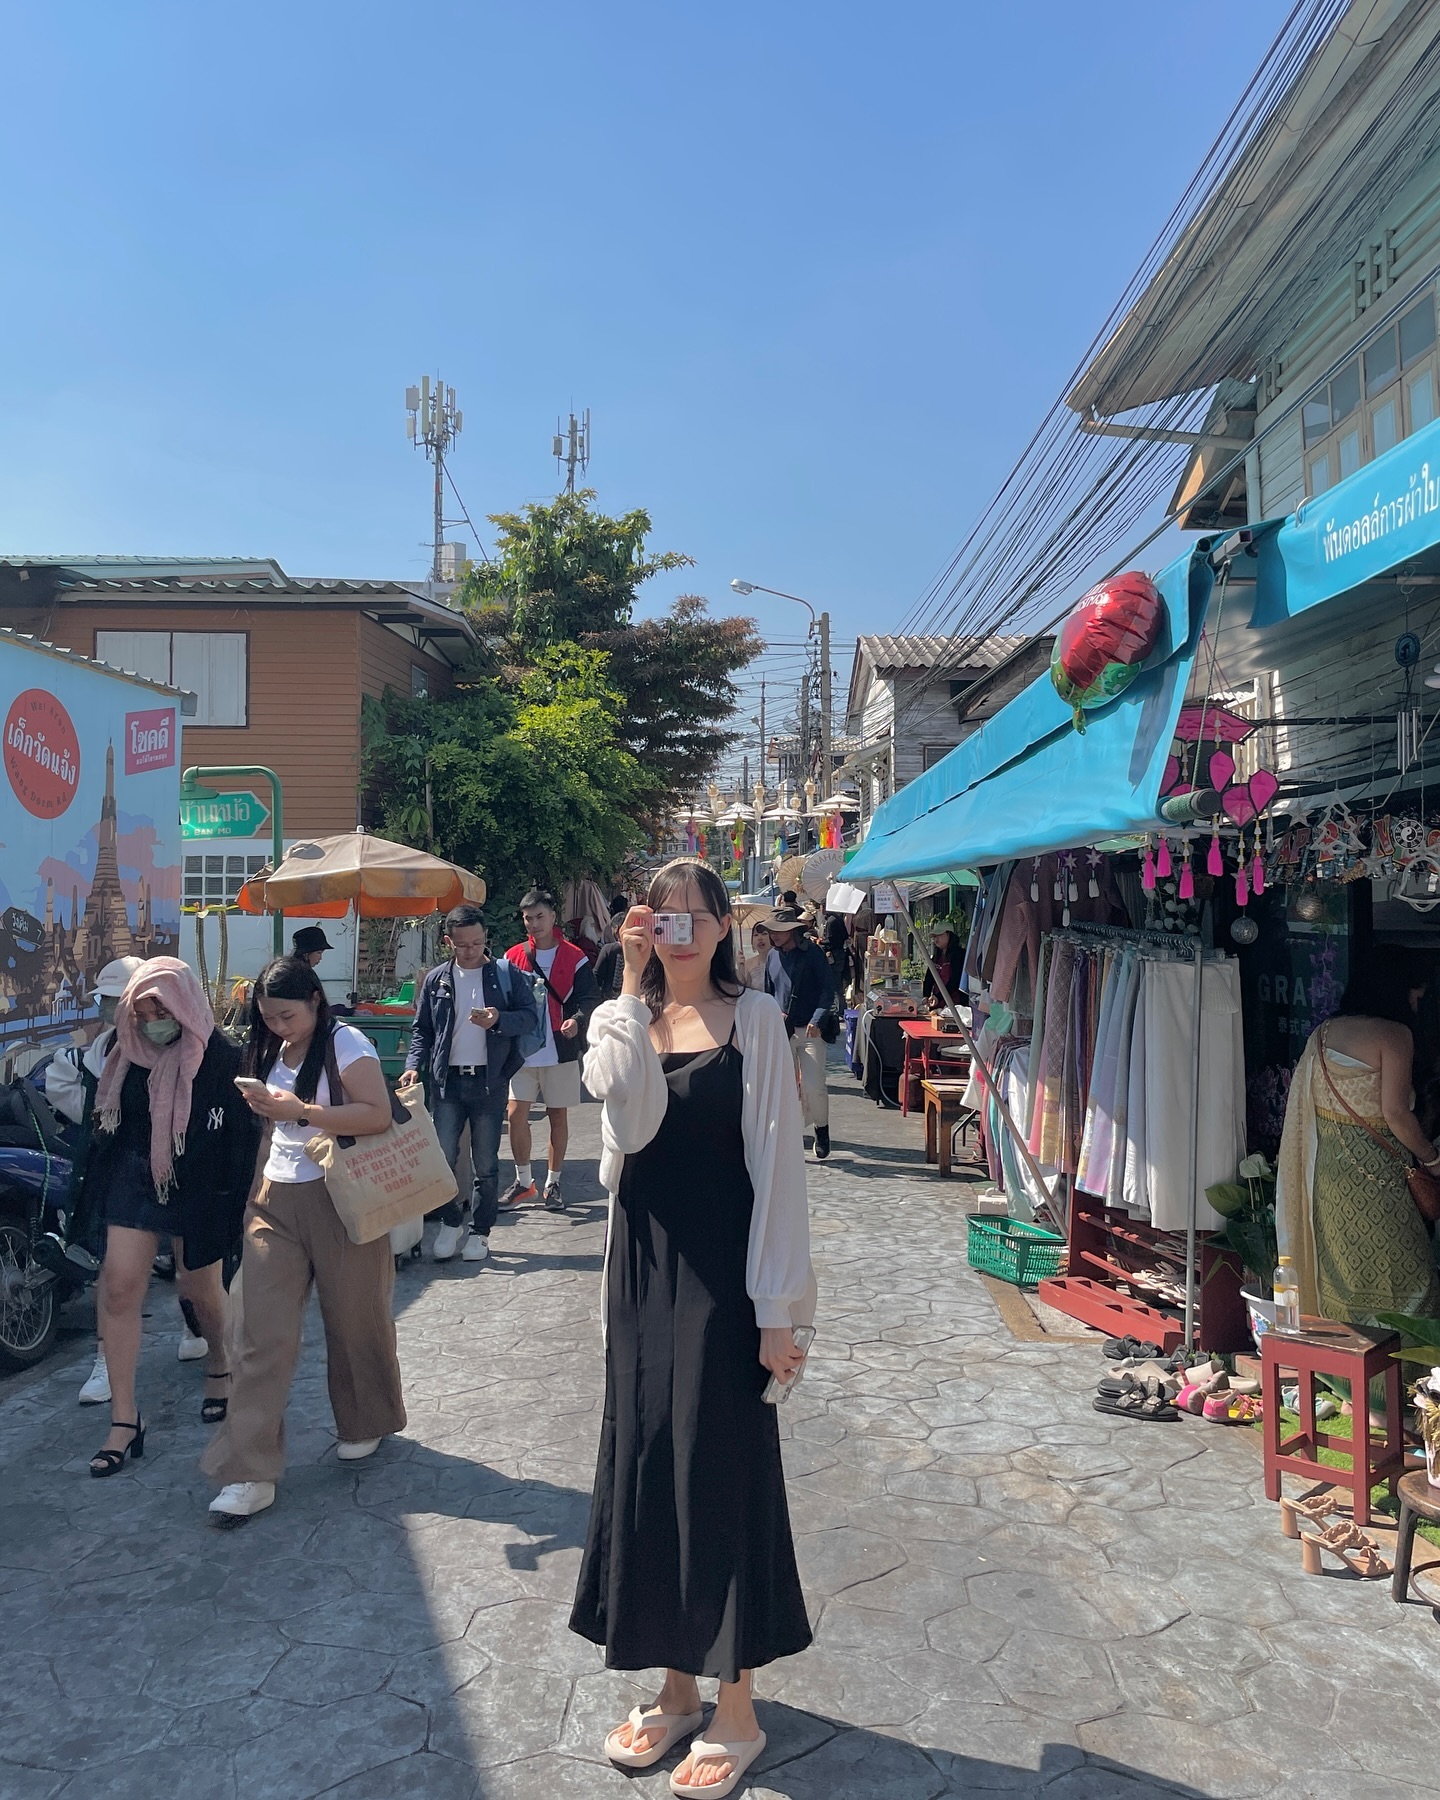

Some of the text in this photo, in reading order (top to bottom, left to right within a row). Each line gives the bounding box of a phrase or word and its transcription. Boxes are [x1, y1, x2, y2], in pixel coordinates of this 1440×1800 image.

[7, 717, 77, 785] เด็กวัดแจ้ง
[130, 716, 170, 755] โชคดี
[10, 755, 67, 809] Wang Doem Rd
[194, 828, 214, 836] BAN
[217, 826, 232, 835] MO
[36, 928, 42, 941] 7
[206, 1106, 225, 1131] NY
[345, 1127, 421, 1170] FASHION HAPPY
[348, 1137, 430, 1180] THE BEST THING
